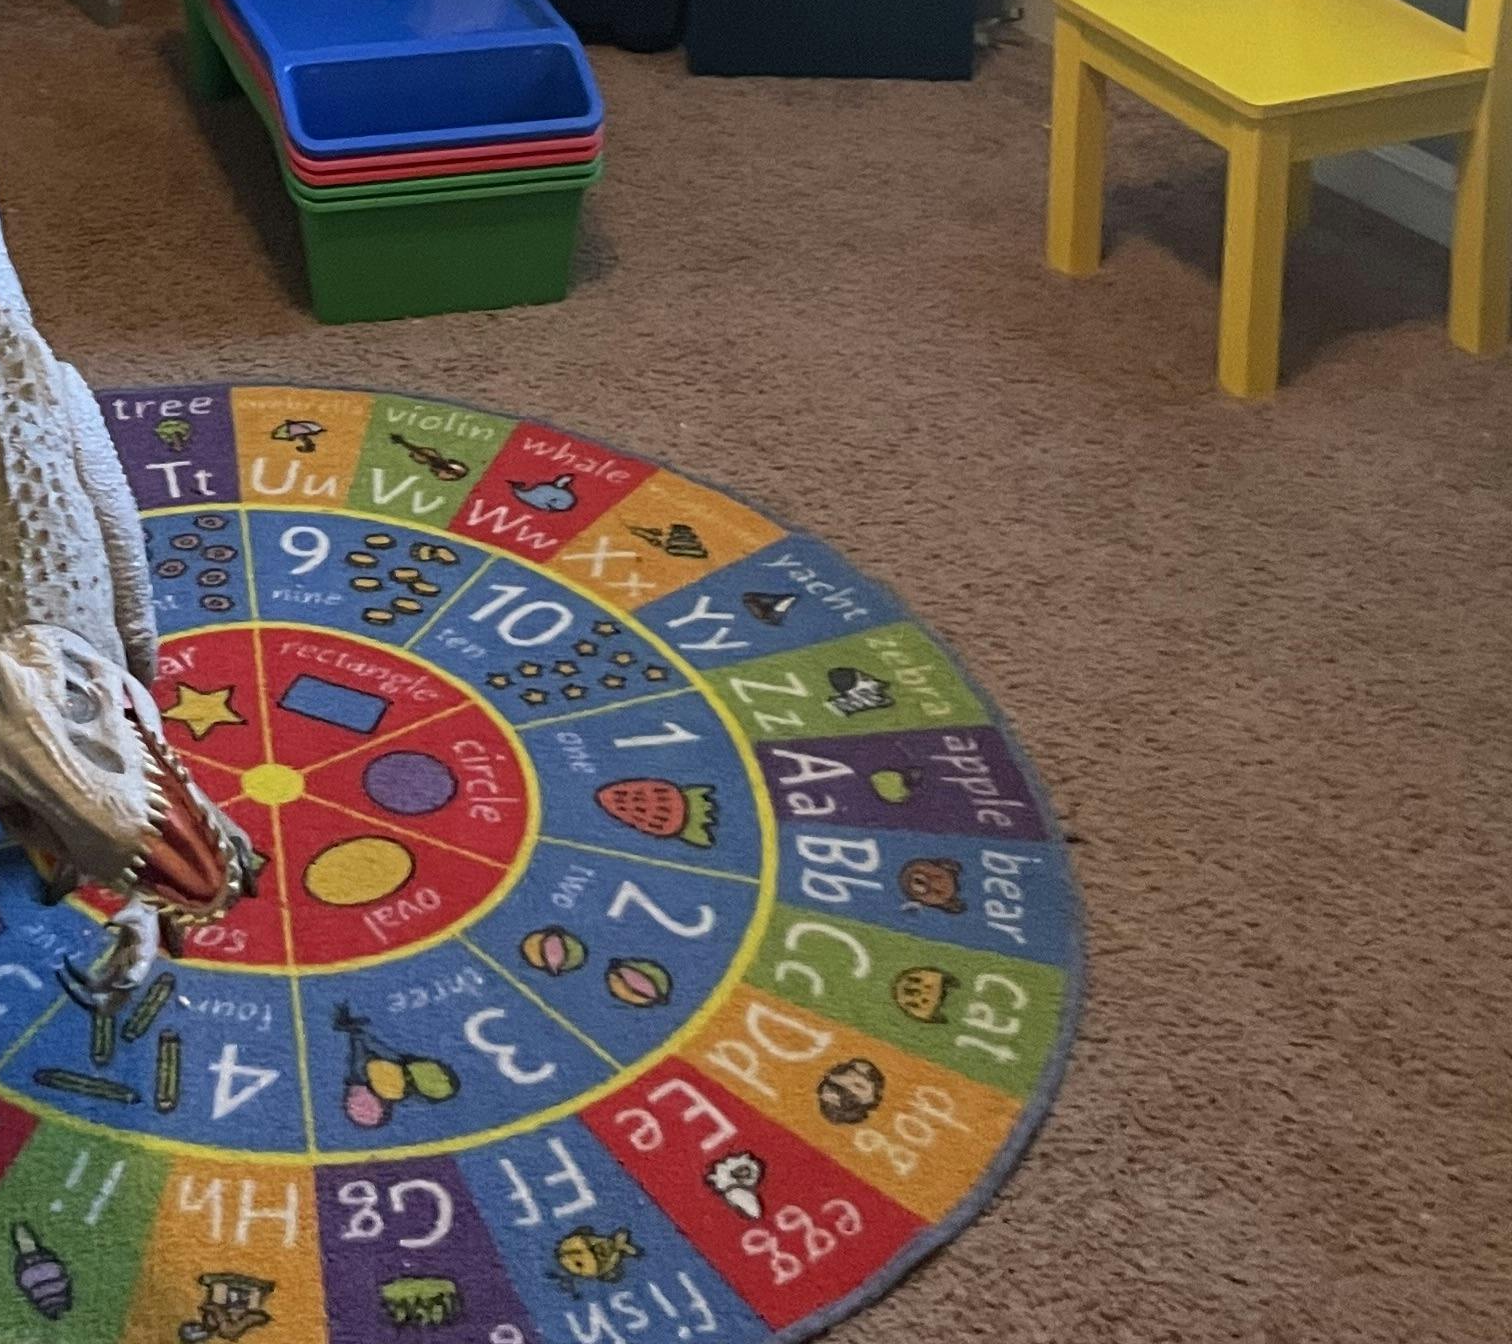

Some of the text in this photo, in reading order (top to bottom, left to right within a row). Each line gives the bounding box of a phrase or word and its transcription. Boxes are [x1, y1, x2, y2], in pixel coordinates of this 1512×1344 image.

[112, 396, 214, 420] tree
[388, 405, 495, 440] violin
[145, 460, 216, 498] Tt
[251, 457, 338, 497] Uu
[371, 467, 447, 514] Vv
[523, 437, 631, 483] whale
[280, 525, 330, 574] 9
[467, 499, 558, 550] Ww
[272, 584, 342, 606] nine
[562, 535, 656, 598] Xx
[763, 553, 869, 622] yacht
[438, 628, 487, 658] ten
[468, 584, 574, 647] 10
[666, 595, 751, 650] Yy
[278, 641, 441, 703] rectangle
[730, 672, 808, 733] Zz
[556, 731, 597, 774] one
[614, 722, 701, 748] 1
[453, 739, 521, 824] circle
[771, 748, 855, 817] Aa
[930, 735, 1026, 828] apple
[552, 863, 597, 909] two
[794, 833, 884, 903] Bb
[980, 849, 1043, 945] bear
[363, 887, 441, 944] oval
[607, 880, 717, 938] 2
[775, 921, 872, 998] Cc
[463, 1008, 557, 1085] 3
[955, 973, 1029, 1063] cat
[207, 1043, 281, 1120] 4
[705, 1002, 832, 1101] Dd
[614, 1078, 738, 1151] Ee
[854, 1085, 971, 1177] dog
[177, 1175, 299, 1249] Hh
[499, 1136, 597, 1226] Ff
[338, 1178, 454, 1249] Gg
[741, 1199, 863, 1286] egg
[566, 1271, 717, 1344] fish
